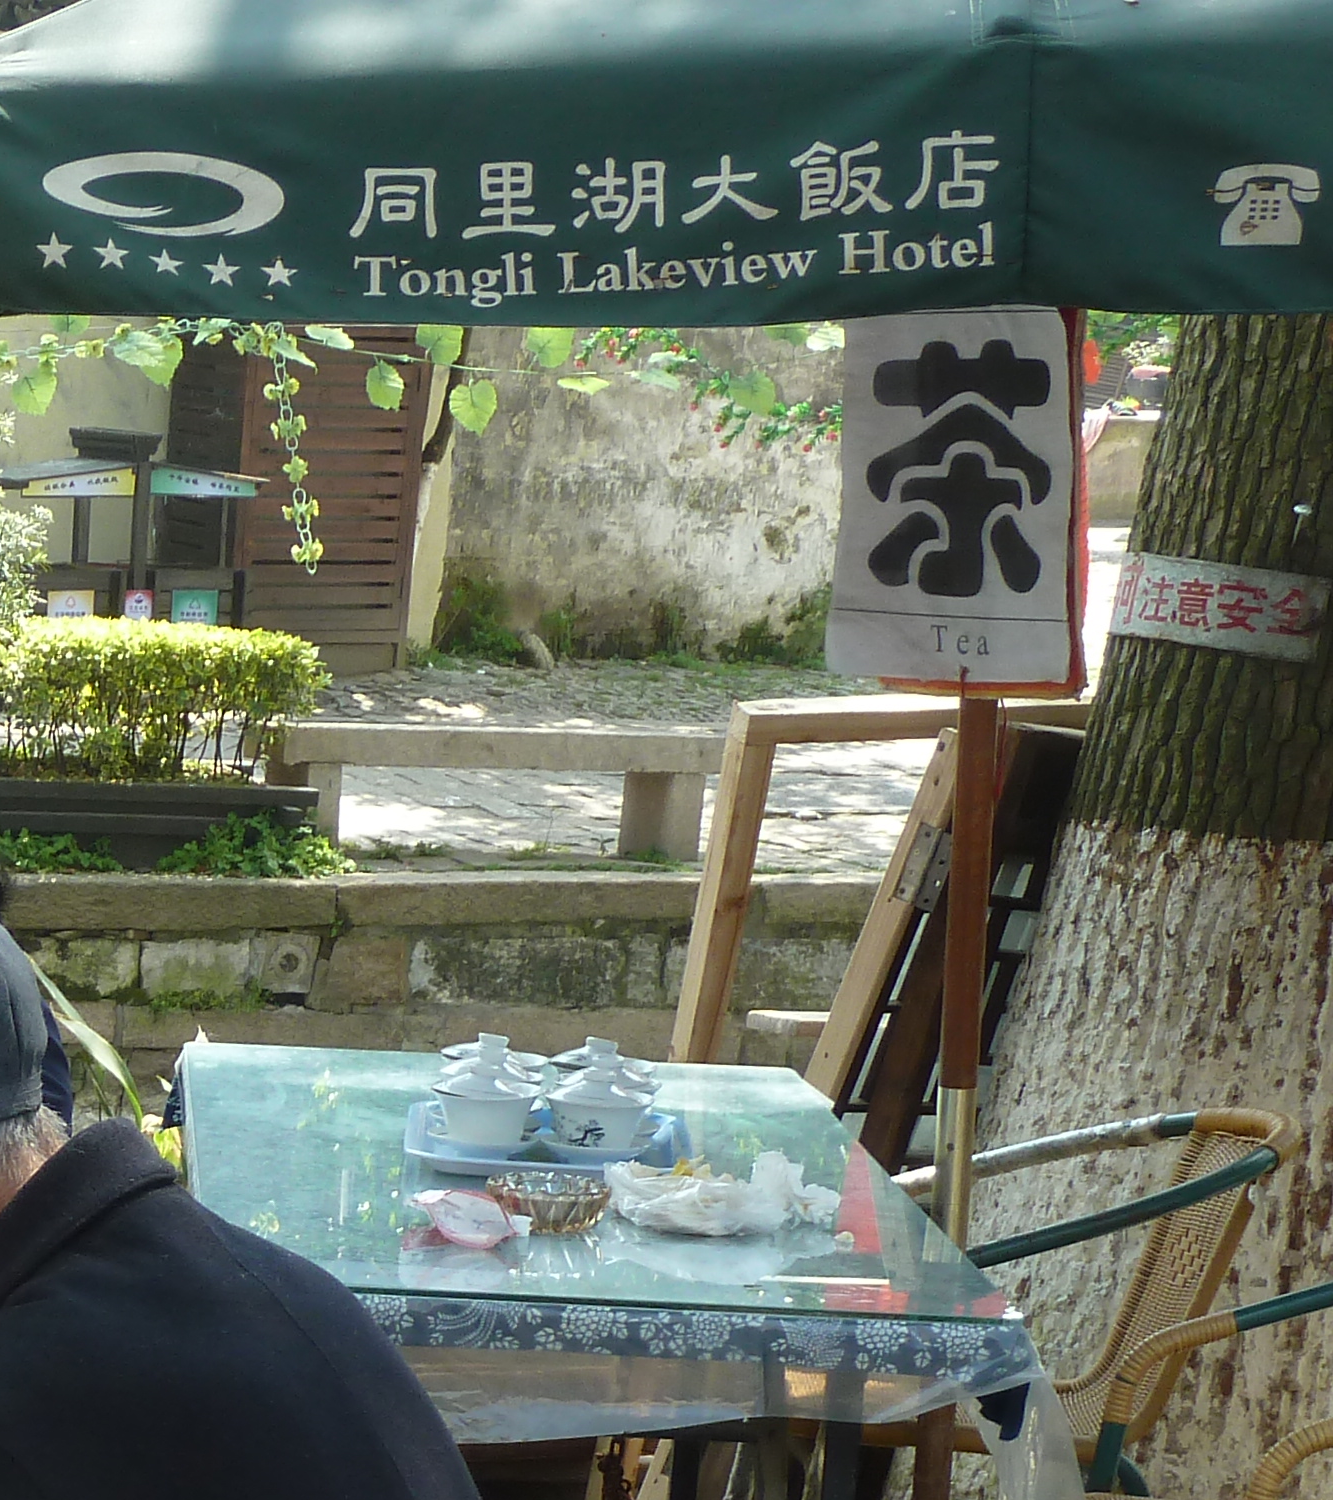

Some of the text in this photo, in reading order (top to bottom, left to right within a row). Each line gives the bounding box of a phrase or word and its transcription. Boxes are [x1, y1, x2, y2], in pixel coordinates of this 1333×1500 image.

[349, 130, 1000, 239] 同里湖大飯店
[353, 221, 996, 308] Tongli Lakeview Hotel
[866, 338, 1053, 598] 茶
[930, 624, 990, 655] Tea
